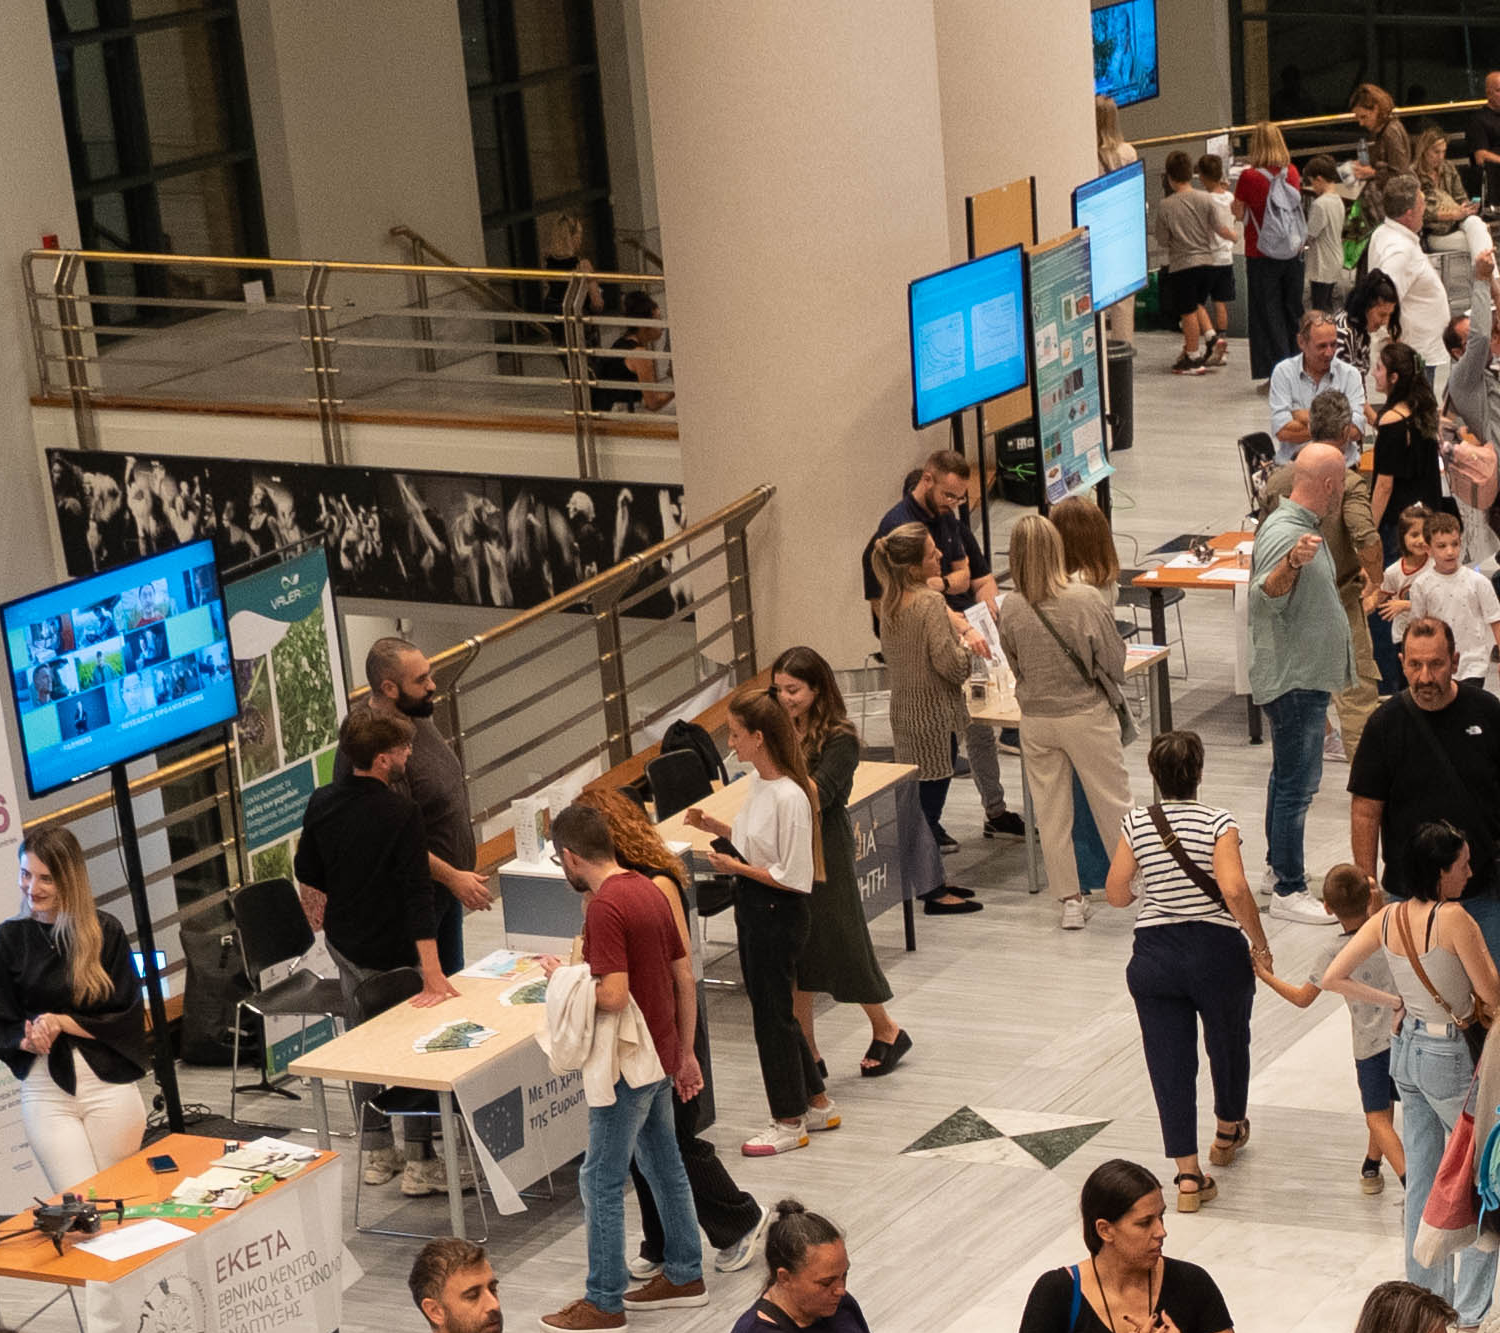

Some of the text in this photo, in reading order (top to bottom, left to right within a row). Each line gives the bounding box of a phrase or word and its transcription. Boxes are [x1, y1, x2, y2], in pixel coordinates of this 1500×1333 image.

[528, 1085, 544, 1105] Με
[545, 1078, 561, 1101] τη
[529, 1112, 549, 1131] της
[216, 1229, 291, 1284] ΕΚΕΤΑ
[218, 1250, 317, 1310] ΕΘΝΙΚΟ ΚΕΝΤΡΟ
[220, 1289, 282, 1329] ΕΡΕΥΝΑΣ
[284, 1285, 293, 1301] &
